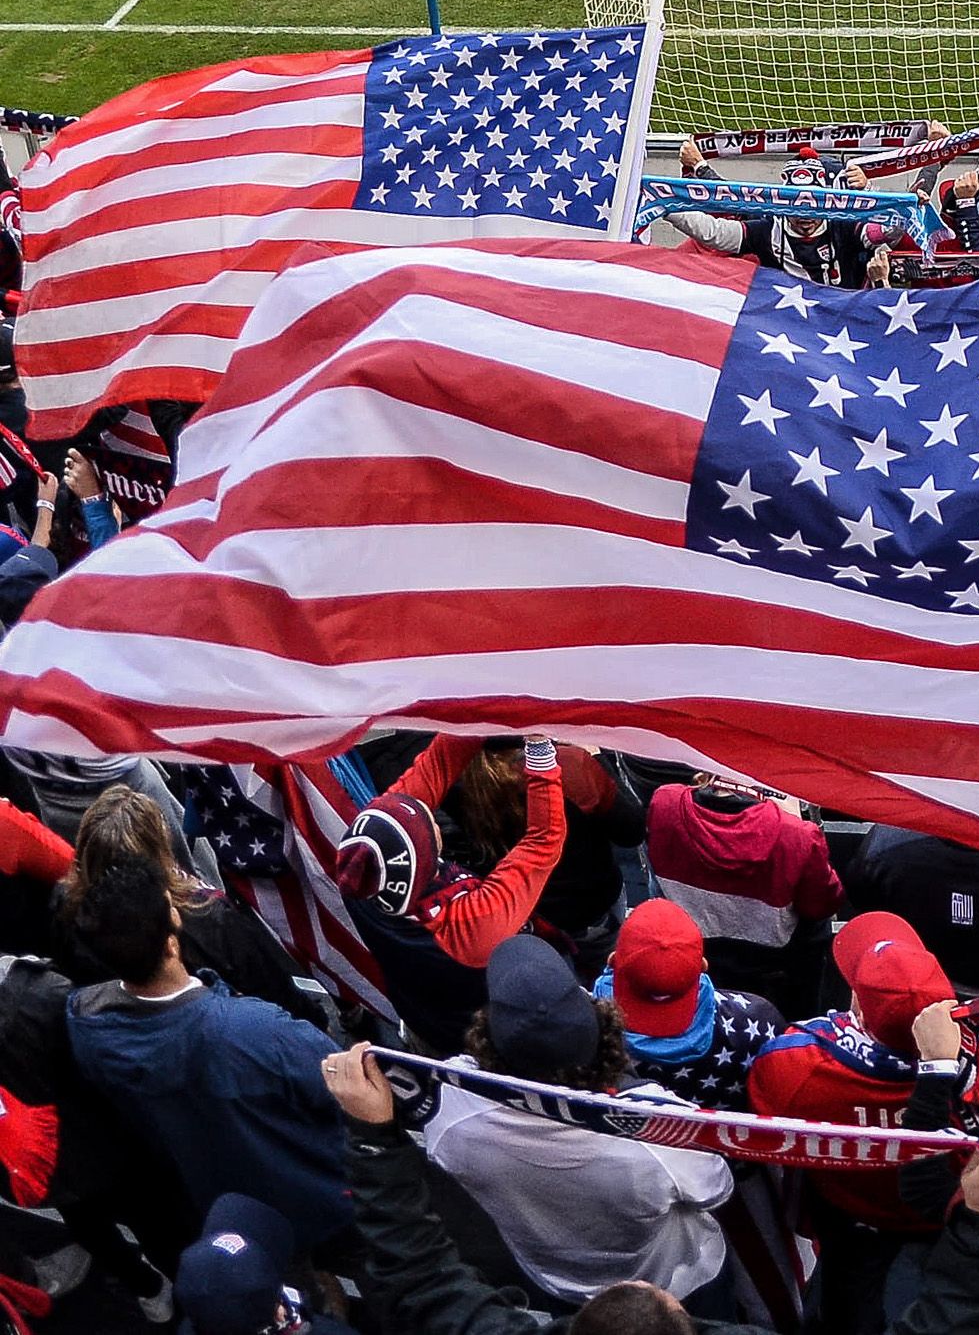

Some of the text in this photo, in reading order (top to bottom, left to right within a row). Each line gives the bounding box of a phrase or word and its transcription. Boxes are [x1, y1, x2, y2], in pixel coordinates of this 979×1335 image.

[766, 129, 824, 145] NEVER
[830, 125, 913, 141] OUTLAWS
[725, 134, 760, 149] SAY
[689, 182, 878, 210] OAKLAND
